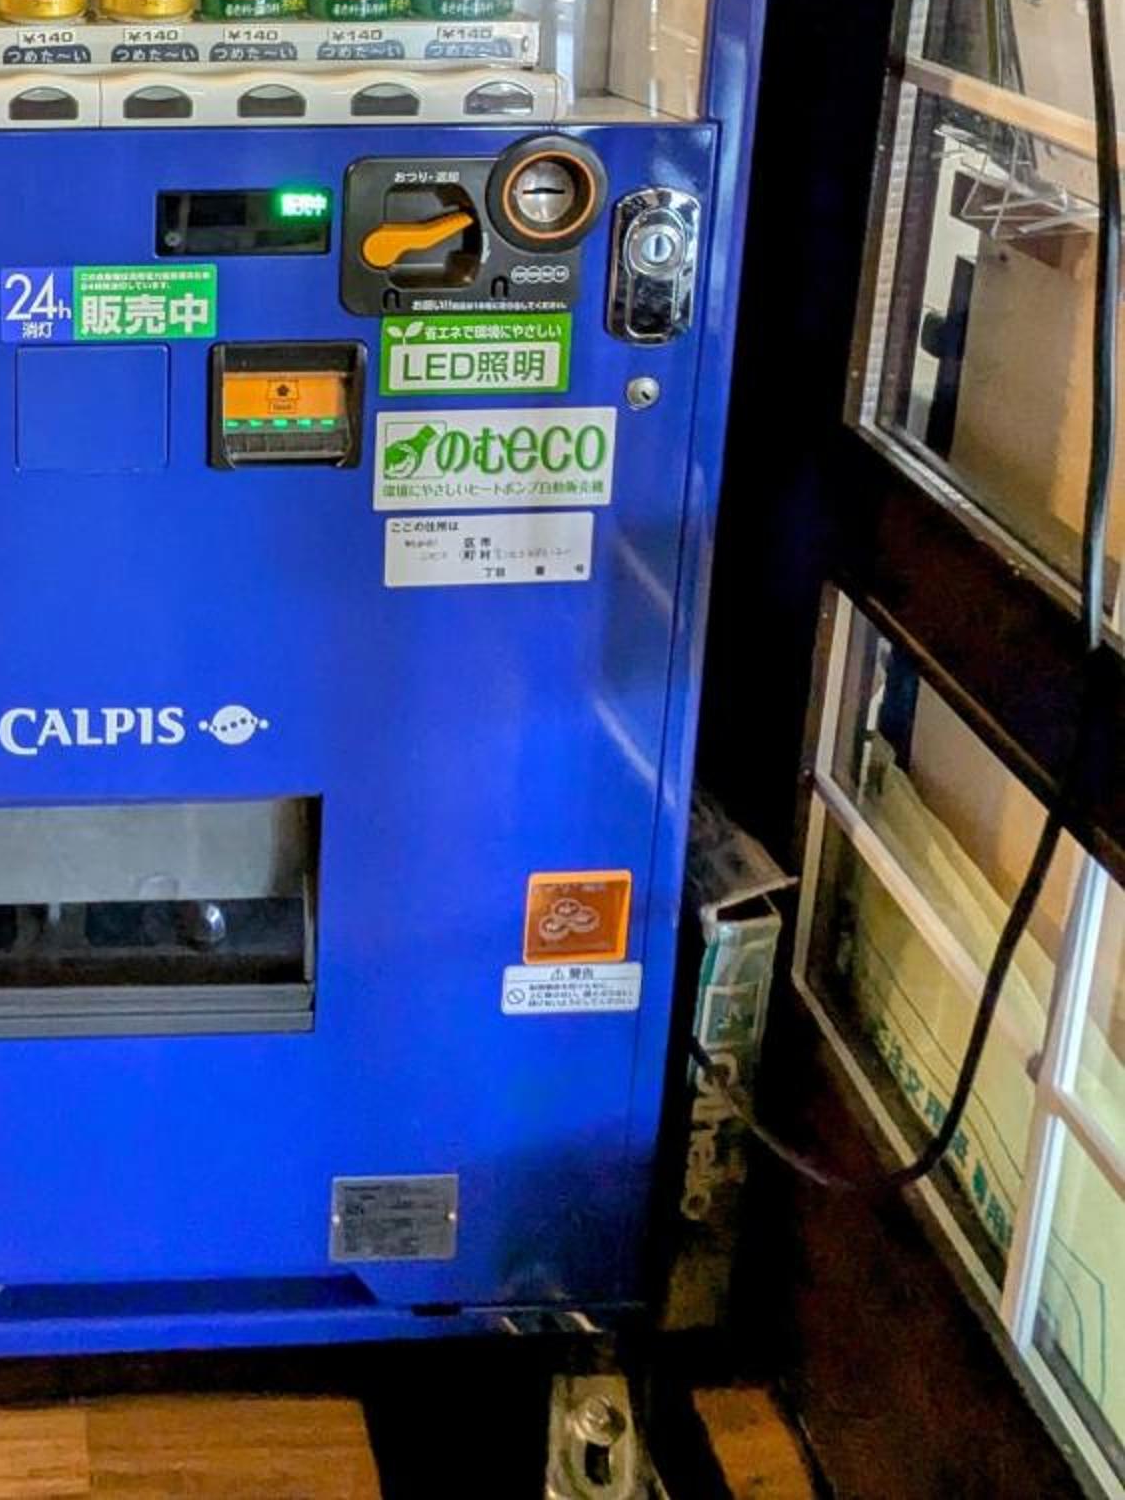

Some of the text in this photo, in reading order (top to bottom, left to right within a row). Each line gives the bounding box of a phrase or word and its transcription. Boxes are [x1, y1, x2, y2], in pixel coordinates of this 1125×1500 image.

[22, 32, 74, 44] ¥140
[127, 30, 179, 42] ¥140
[228, 29, 279, 42] ¥140
[331, 29, 383, 42] ¥140
[5, 272, 72, 321] 24h
[81, 292, 209, 335] 販売中
[22, 321, 54, 339] 消灯
[425, 323, 562, 341] 省エネで環境にやさしい
[402, 350, 546, 382] LED照明
[435, 424, 607, 474] のむeco
[391, 521, 459, 534] ここの住所は
